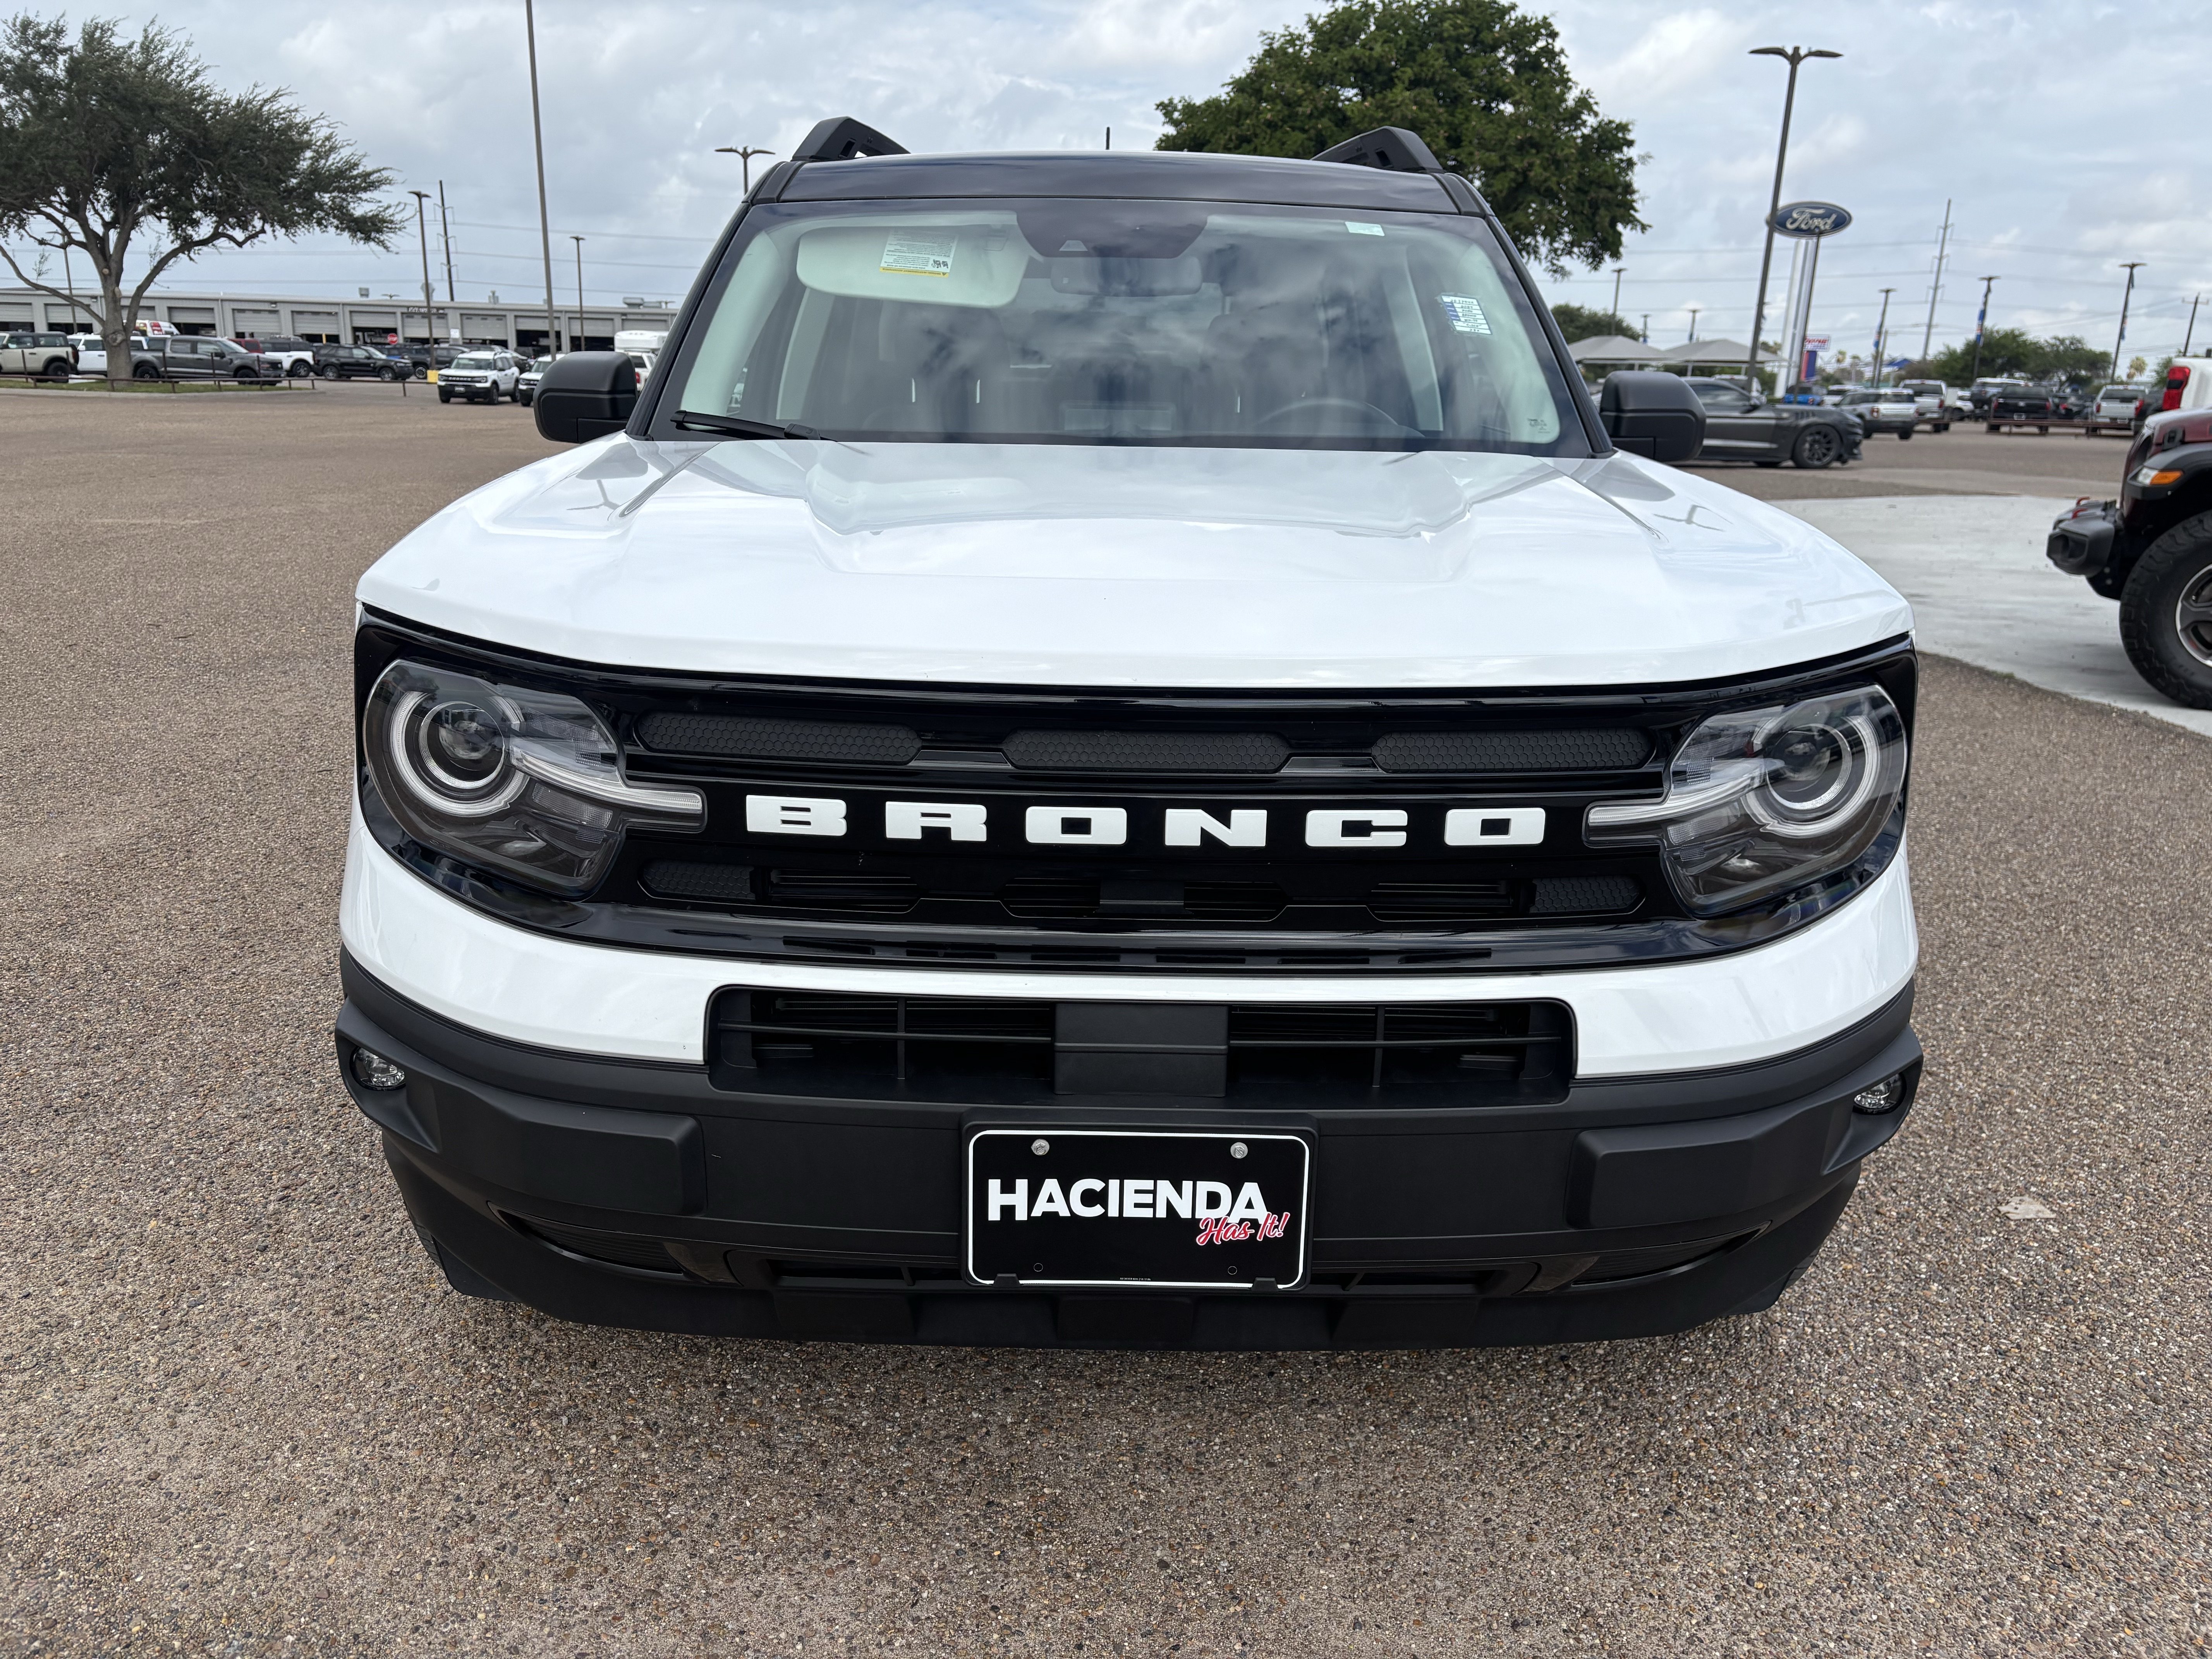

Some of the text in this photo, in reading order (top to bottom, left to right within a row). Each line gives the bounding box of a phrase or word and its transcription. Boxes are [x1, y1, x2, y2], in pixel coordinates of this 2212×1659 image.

[1786, 208, 1837, 230] Ford
[746, 795, 1546, 847] BRONCO
[988, 1178, 1268, 1224] HACIENDA
[1196, 1212, 1291, 1245] Has It!
